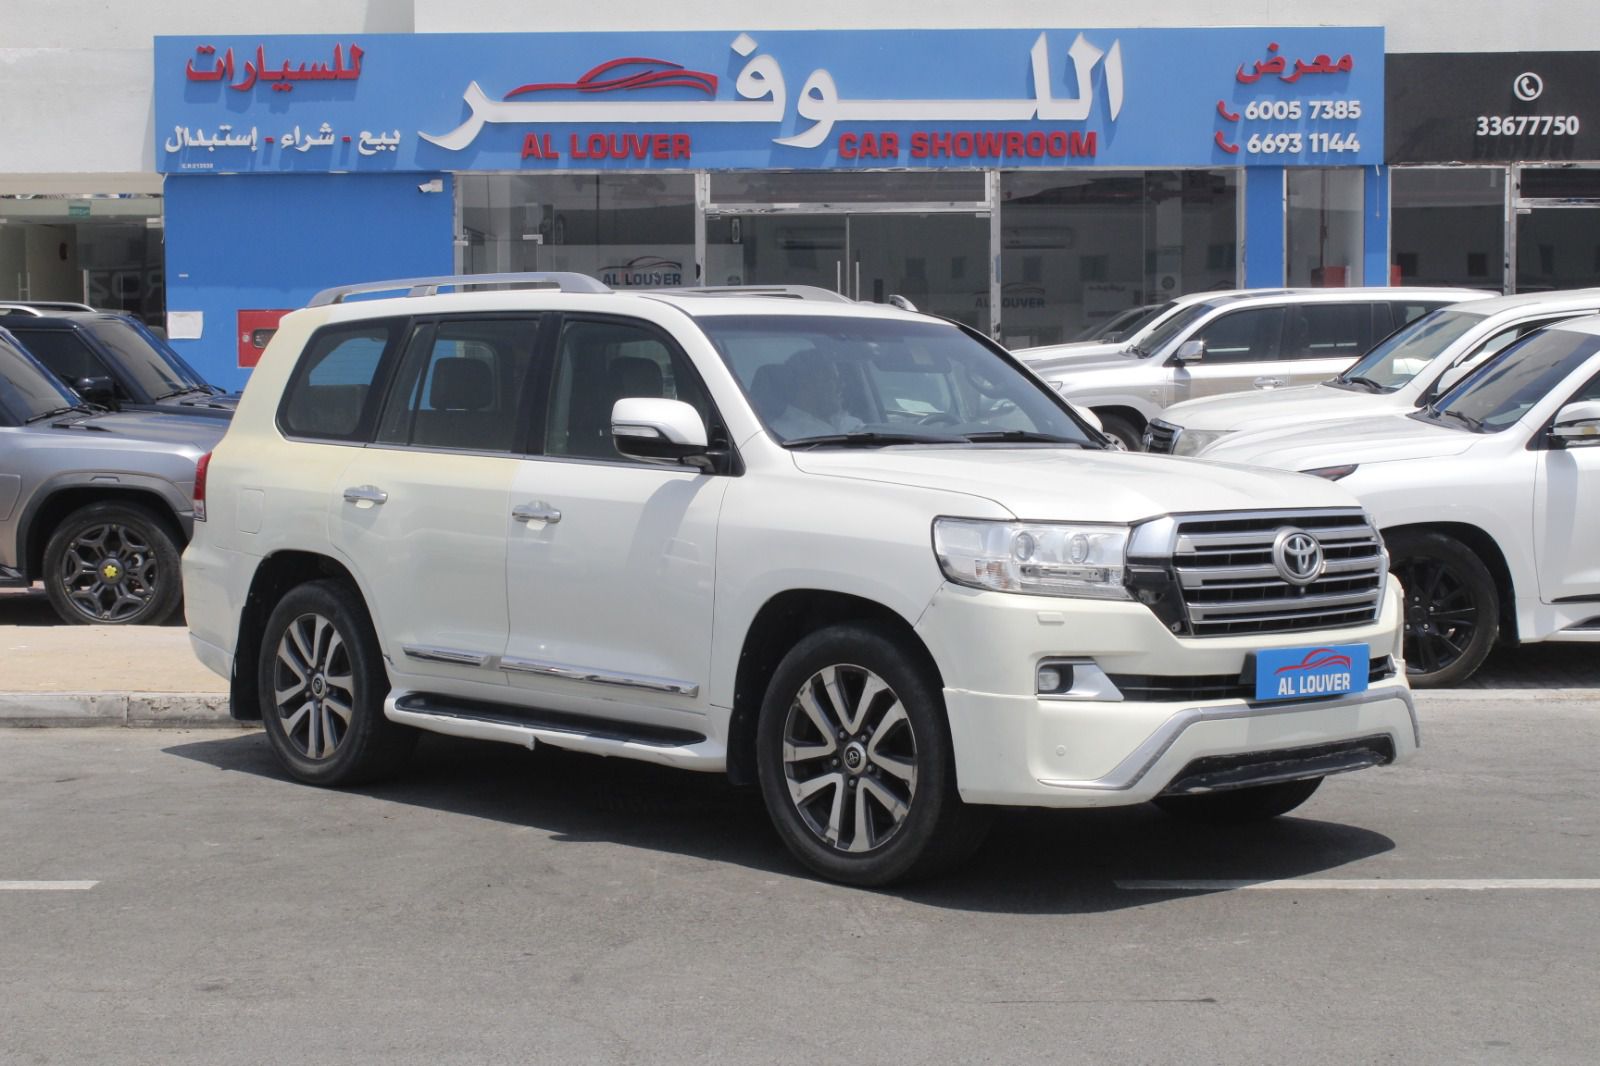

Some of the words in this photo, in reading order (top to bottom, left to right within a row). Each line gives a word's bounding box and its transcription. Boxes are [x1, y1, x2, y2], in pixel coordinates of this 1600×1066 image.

[186, 43, 363, 91] للسيارات
[1237, 43, 1353, 84] معرض
[1245, 100, 1302, 120] 6005
[1308, 100, 1362, 119] 7385
[280, 122, 335, 152] شراء
[1476, 115, 1580, 136] 33677750
[357, 125, 401, 157] بيع
[521, 133, 560, 159] AL
[570, 133, 691, 159] LOUVER
[839, 132, 899, 158] CAR
[911, 131, 1097, 158] SHOWROOM
[1247, 132, 1303, 154] 6693
[1309, 132, 1362, 153] 1144
[603, 273, 620, 285] AL
[625, 272, 682, 286] LOUVER
[1001, 296, 1046, 309] OUVER
[1278, 677, 1296, 695] AL
[1299, 672, 1351, 694] LOUVER
